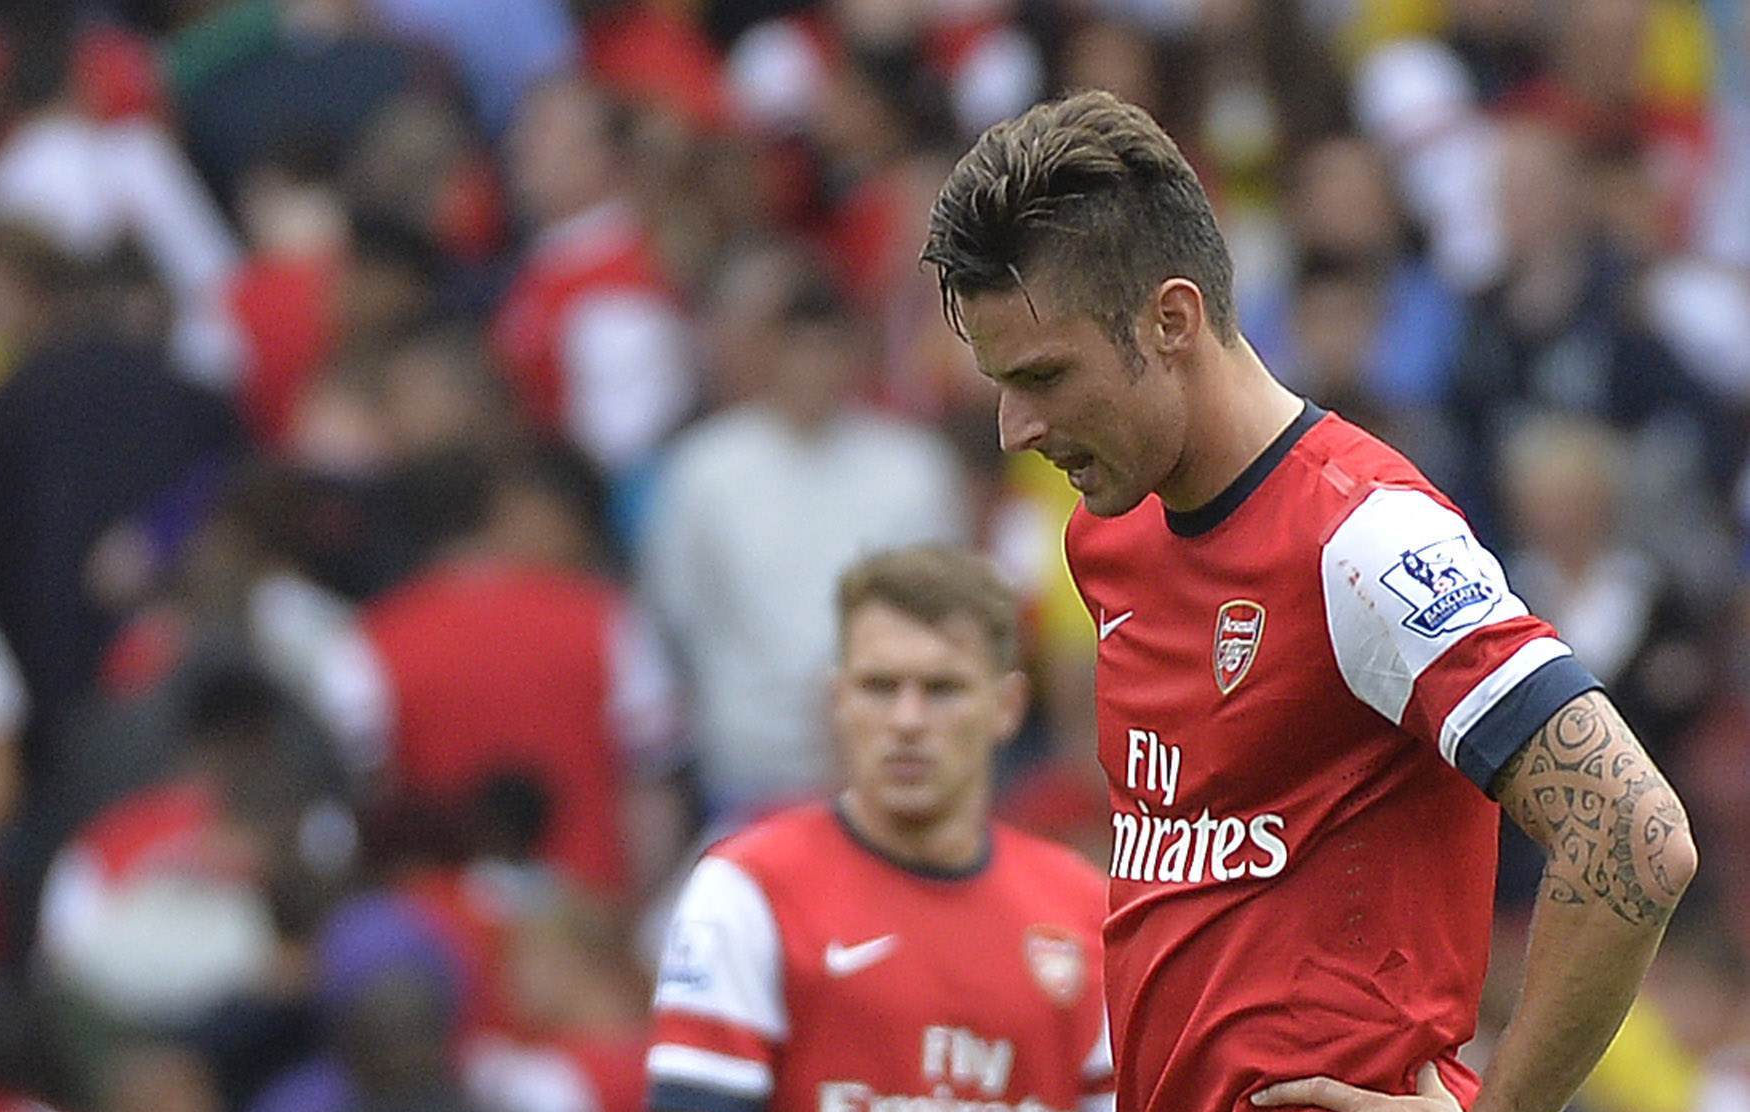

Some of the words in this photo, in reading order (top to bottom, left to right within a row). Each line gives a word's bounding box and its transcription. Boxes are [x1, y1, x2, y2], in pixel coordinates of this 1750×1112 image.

[1126, 727, 1181, 807] Fly
[1109, 799, 1288, 884] mirates
[922, 1024, 1015, 1095] Fly
